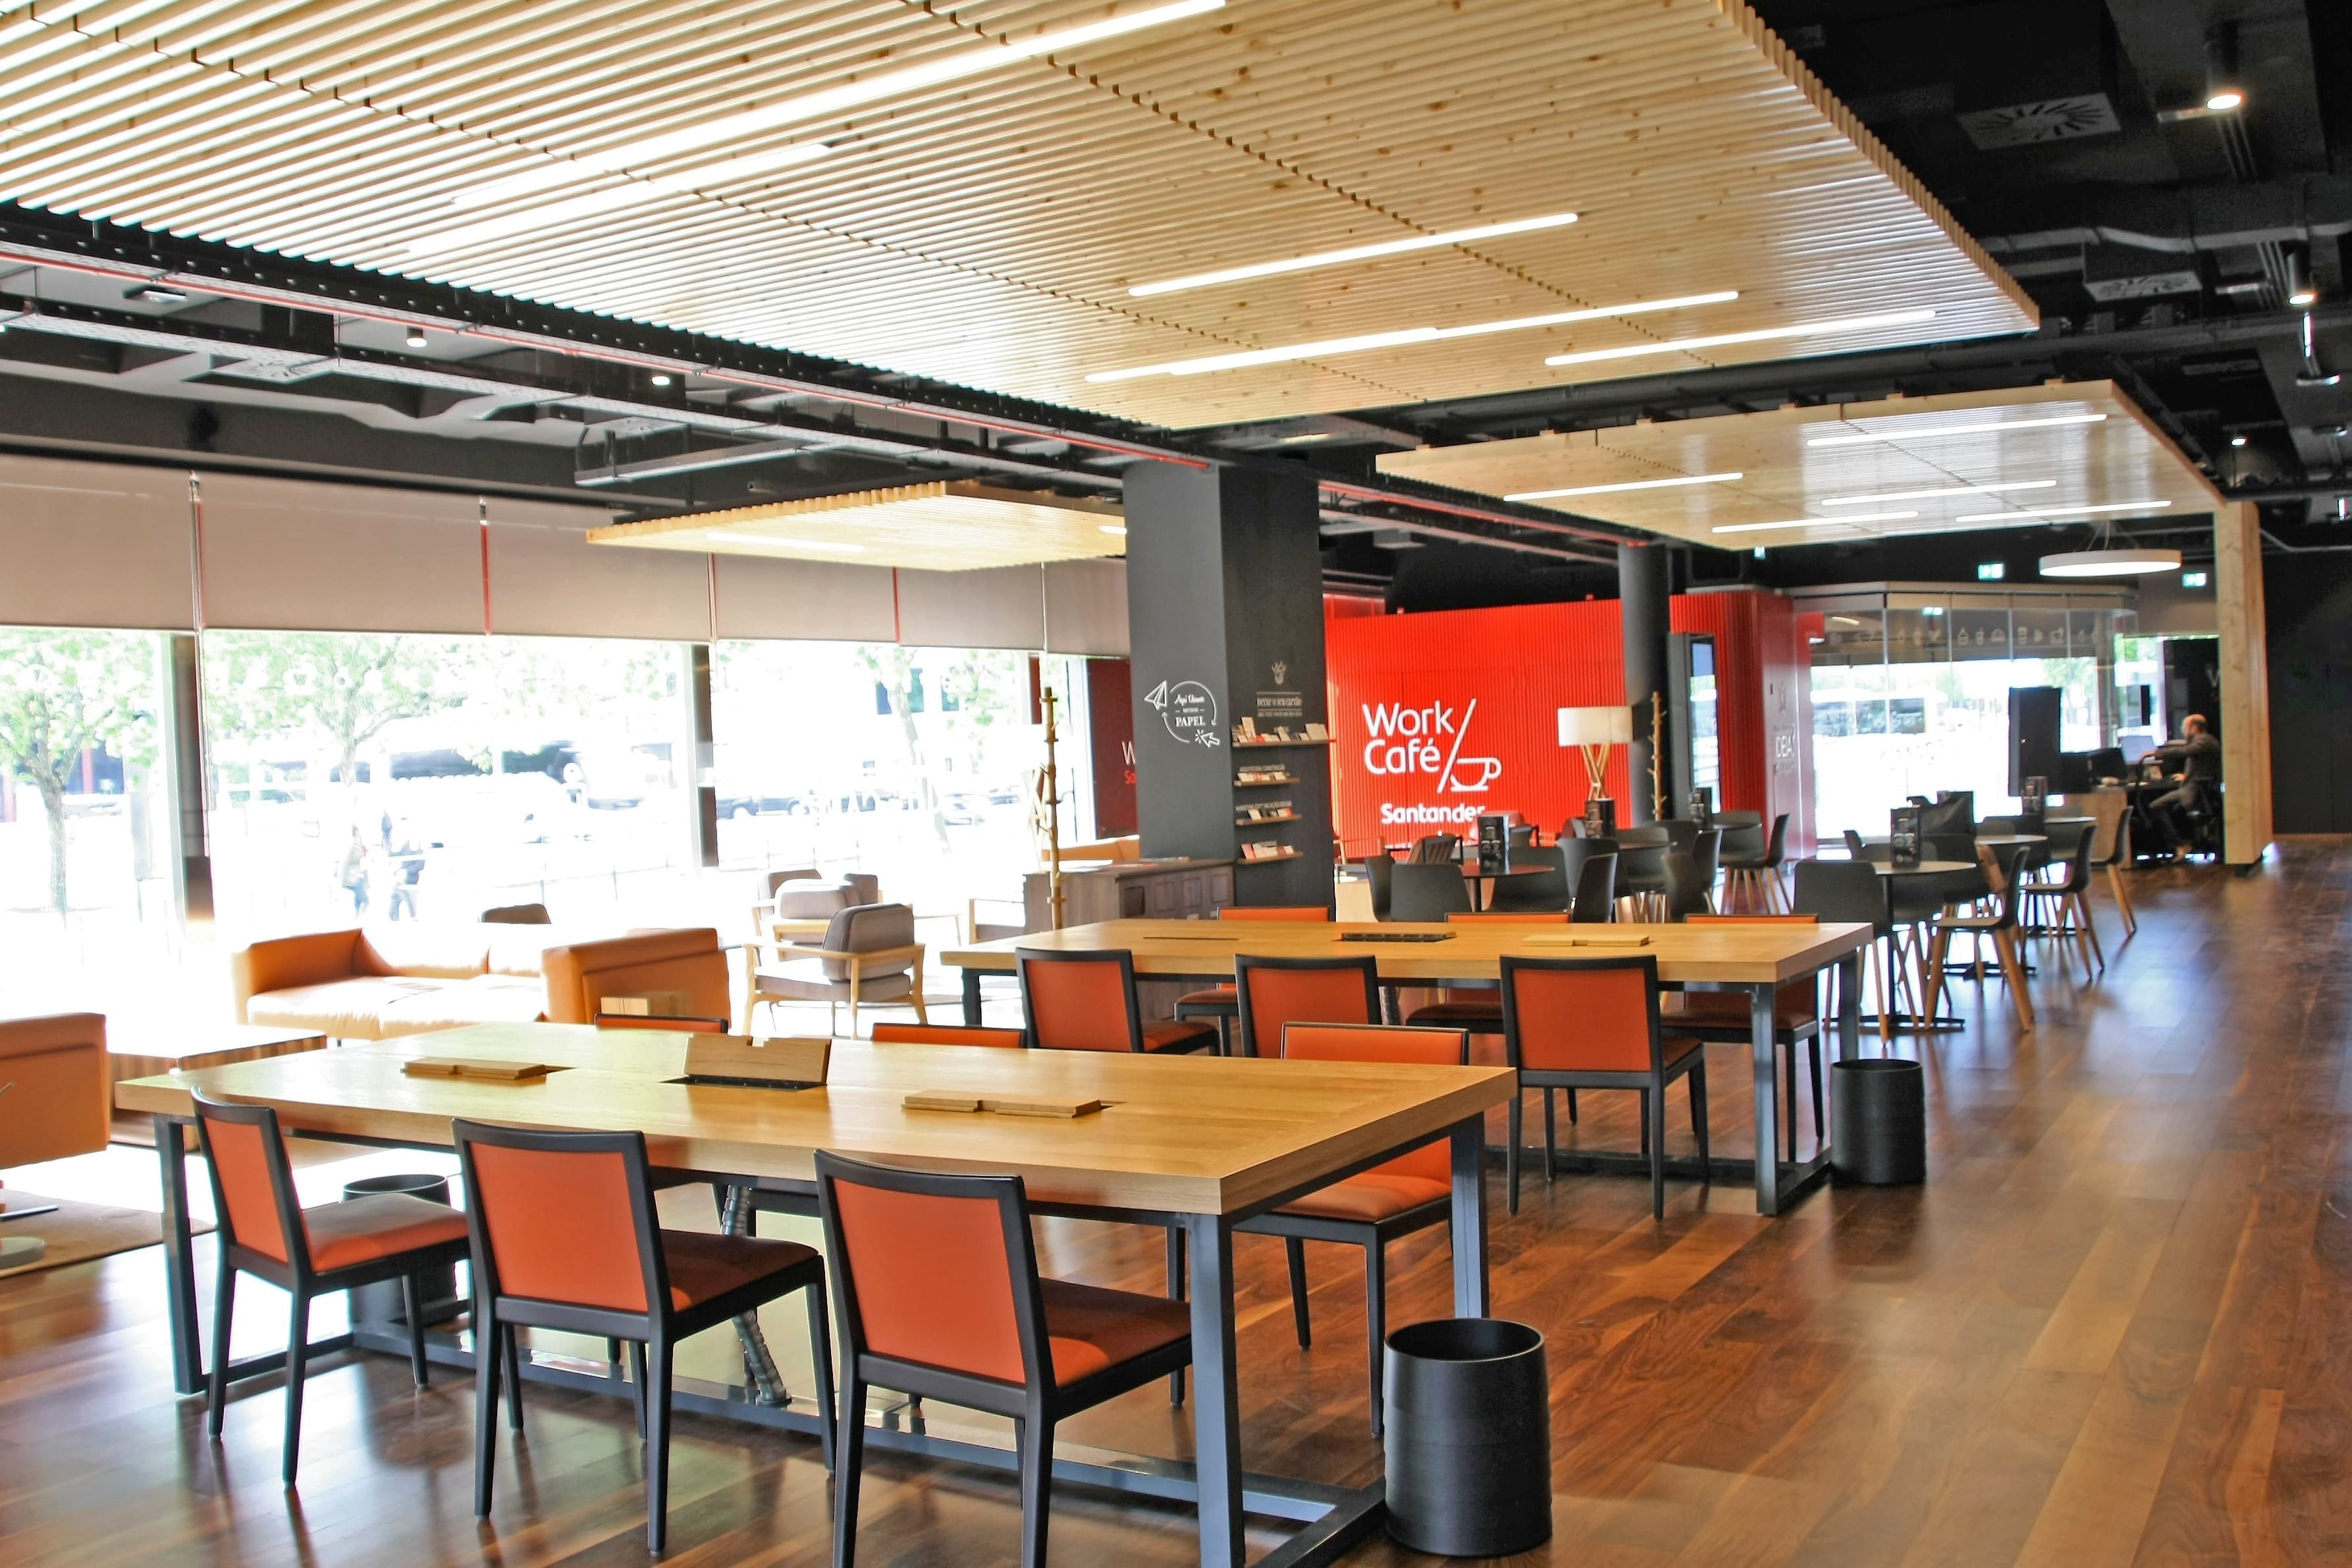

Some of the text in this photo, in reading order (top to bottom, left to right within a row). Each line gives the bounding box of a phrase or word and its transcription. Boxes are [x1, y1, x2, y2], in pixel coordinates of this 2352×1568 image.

[1175, 716, 1206, 727] PAPEL
[1362, 700, 1455, 737] Work
[1364, 737, 1441, 775] Café
[1381, 802, 1486, 824] Santander
